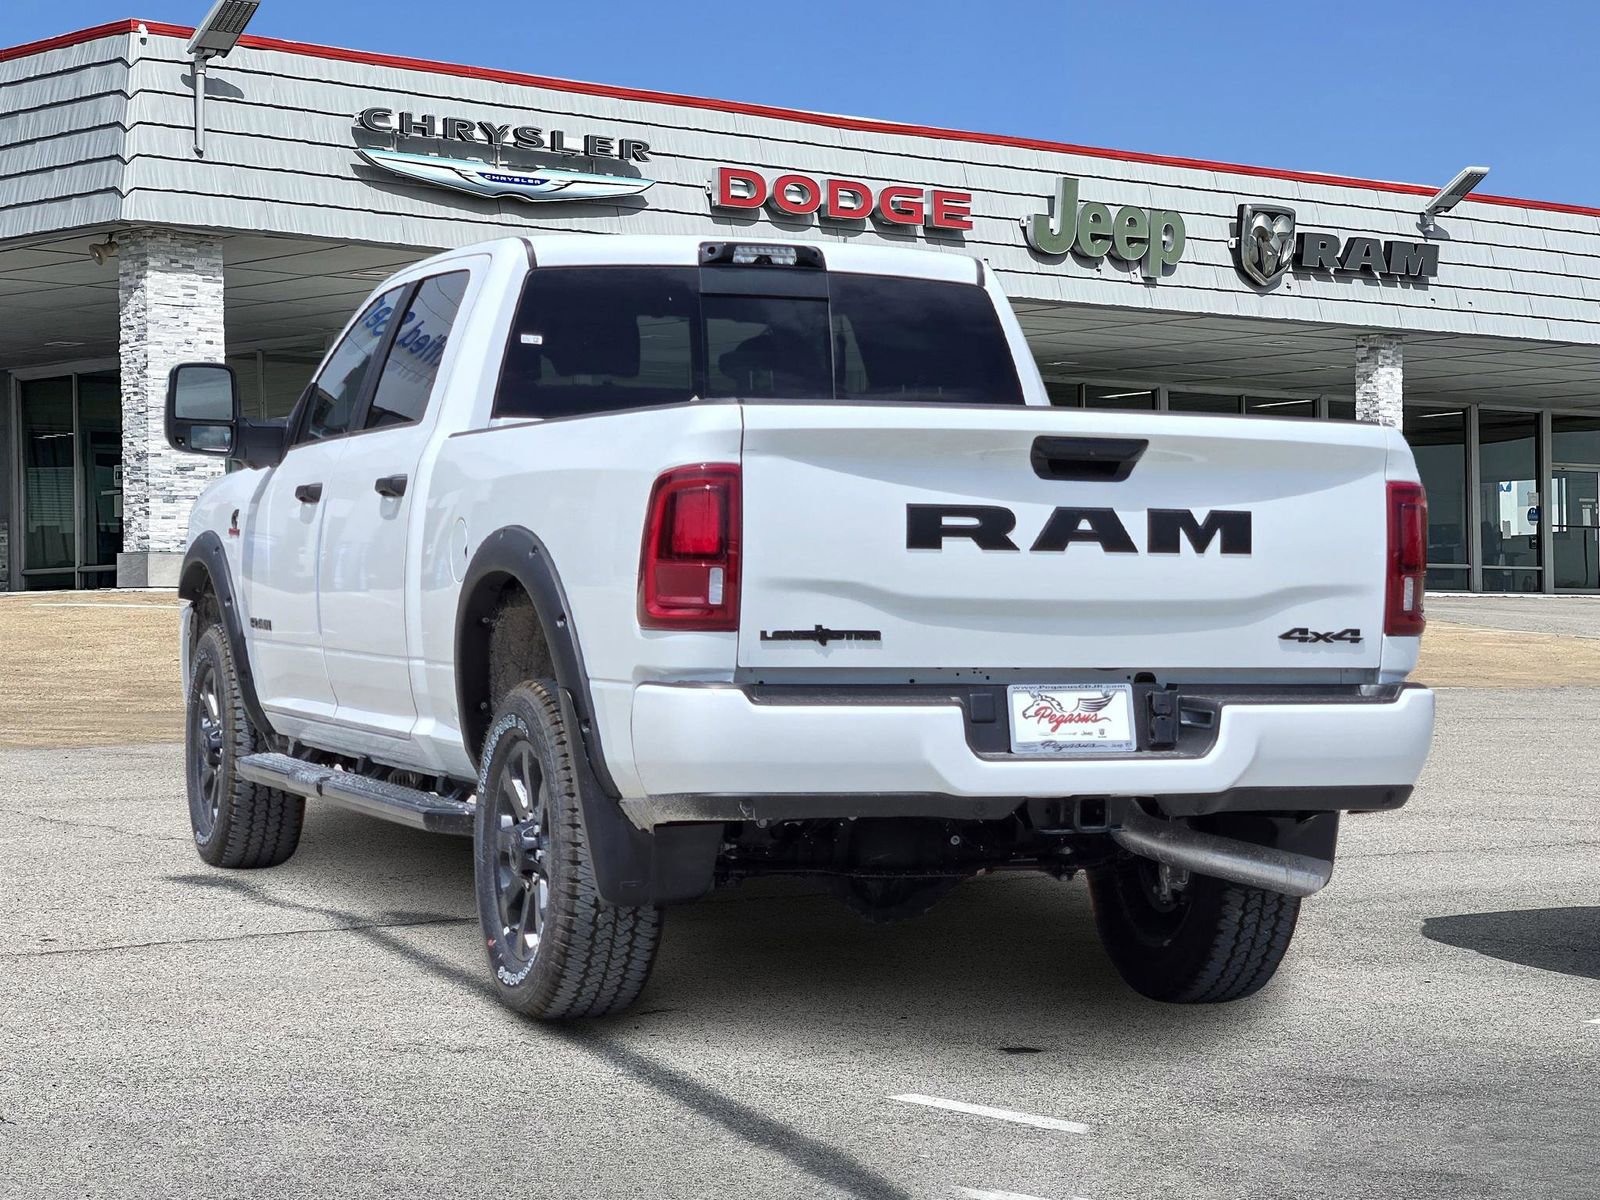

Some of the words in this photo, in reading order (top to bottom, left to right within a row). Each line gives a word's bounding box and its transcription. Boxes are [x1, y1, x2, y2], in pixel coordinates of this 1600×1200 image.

[355, 107, 651, 163] CHRYSLER
[484, 174, 541, 185] CHRYSLER
[711, 166, 974, 232] DODGE
[1028, 176, 1186, 279] Jeep
[1298, 231, 1440, 277] RAM
[906, 503, 1252, 554] RAM
[1278, 627, 1364, 644] 4x4
[1034, 705, 1112, 733] Pegasus
